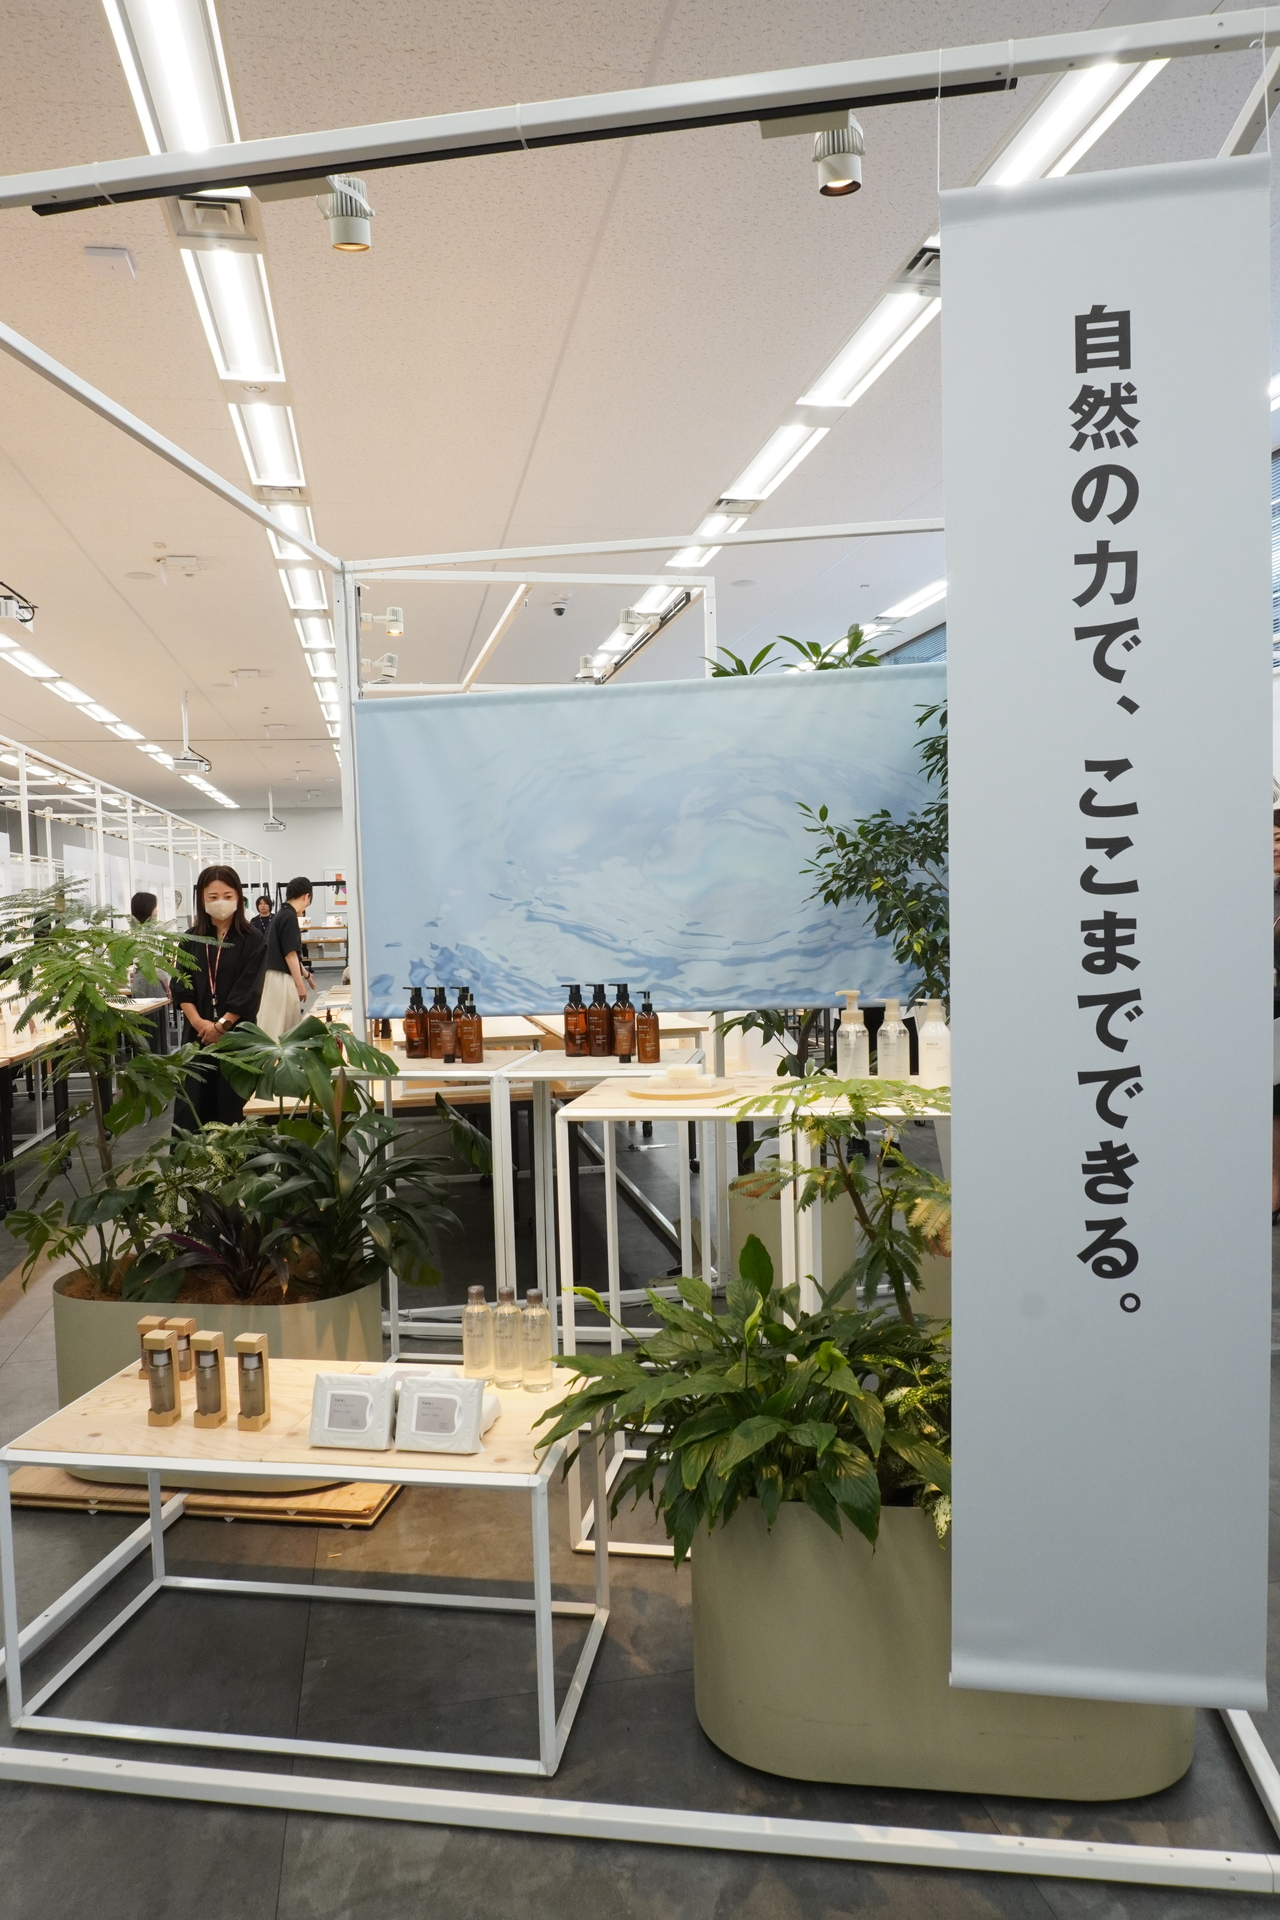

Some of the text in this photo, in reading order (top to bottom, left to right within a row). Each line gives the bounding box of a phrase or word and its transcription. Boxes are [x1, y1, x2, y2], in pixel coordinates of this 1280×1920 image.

[1069, 304, 1144, 1314] 自然の力で、ここまでできる。
